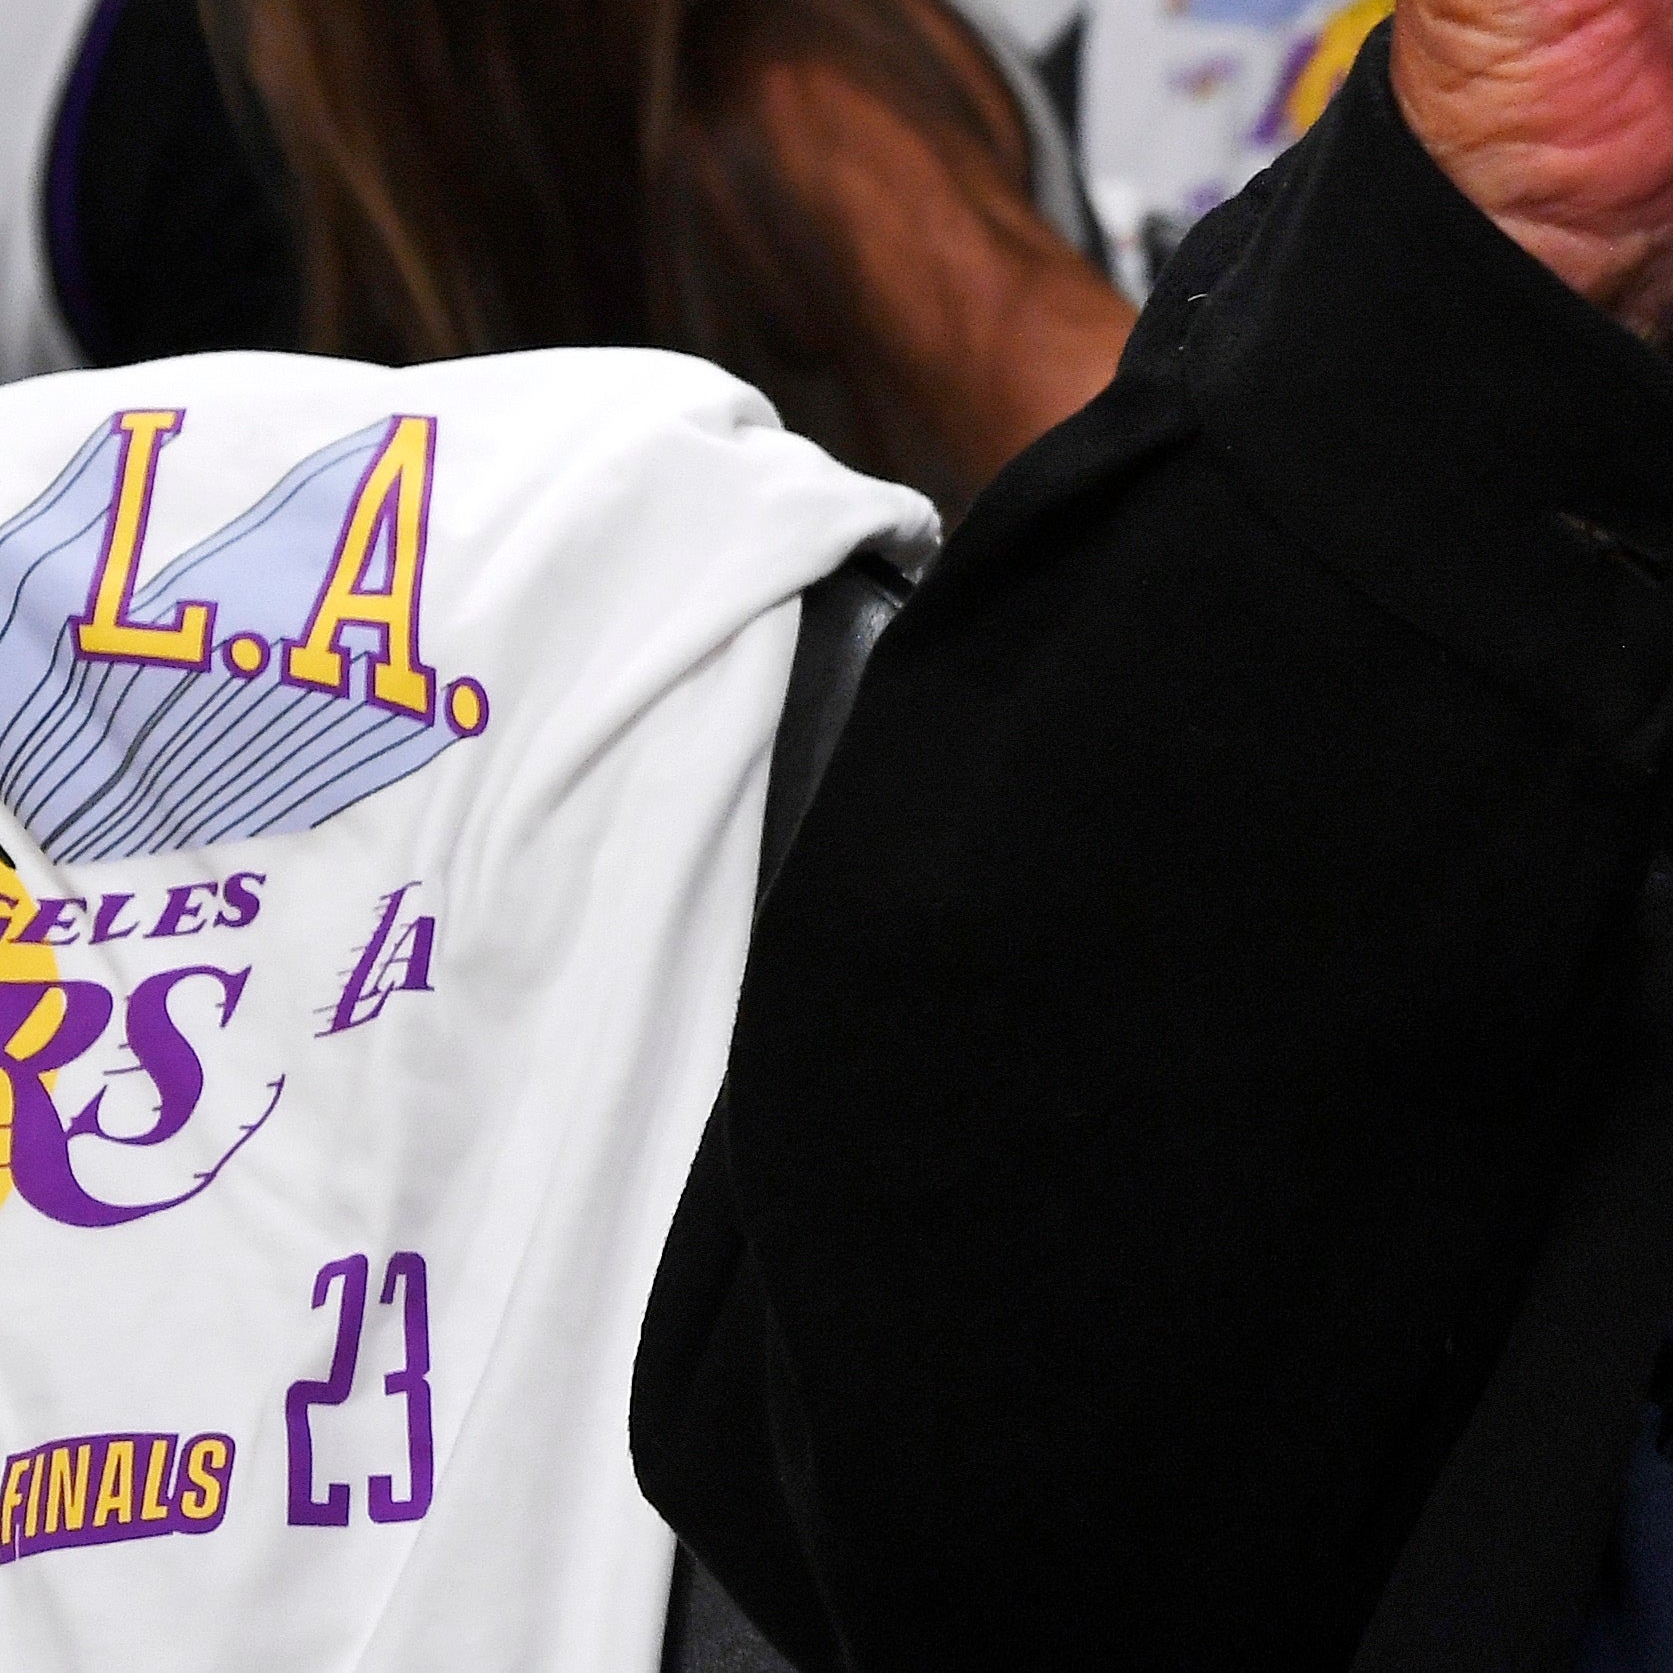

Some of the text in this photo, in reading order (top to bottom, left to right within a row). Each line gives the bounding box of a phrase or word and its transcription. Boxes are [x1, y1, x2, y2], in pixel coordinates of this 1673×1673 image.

[70, 407, 490, 739] L.A.
[314, 881, 434, 1038] LA
[2, 1439, 226, 1544] FINALS
[286, 1249, 435, 1527] 23
